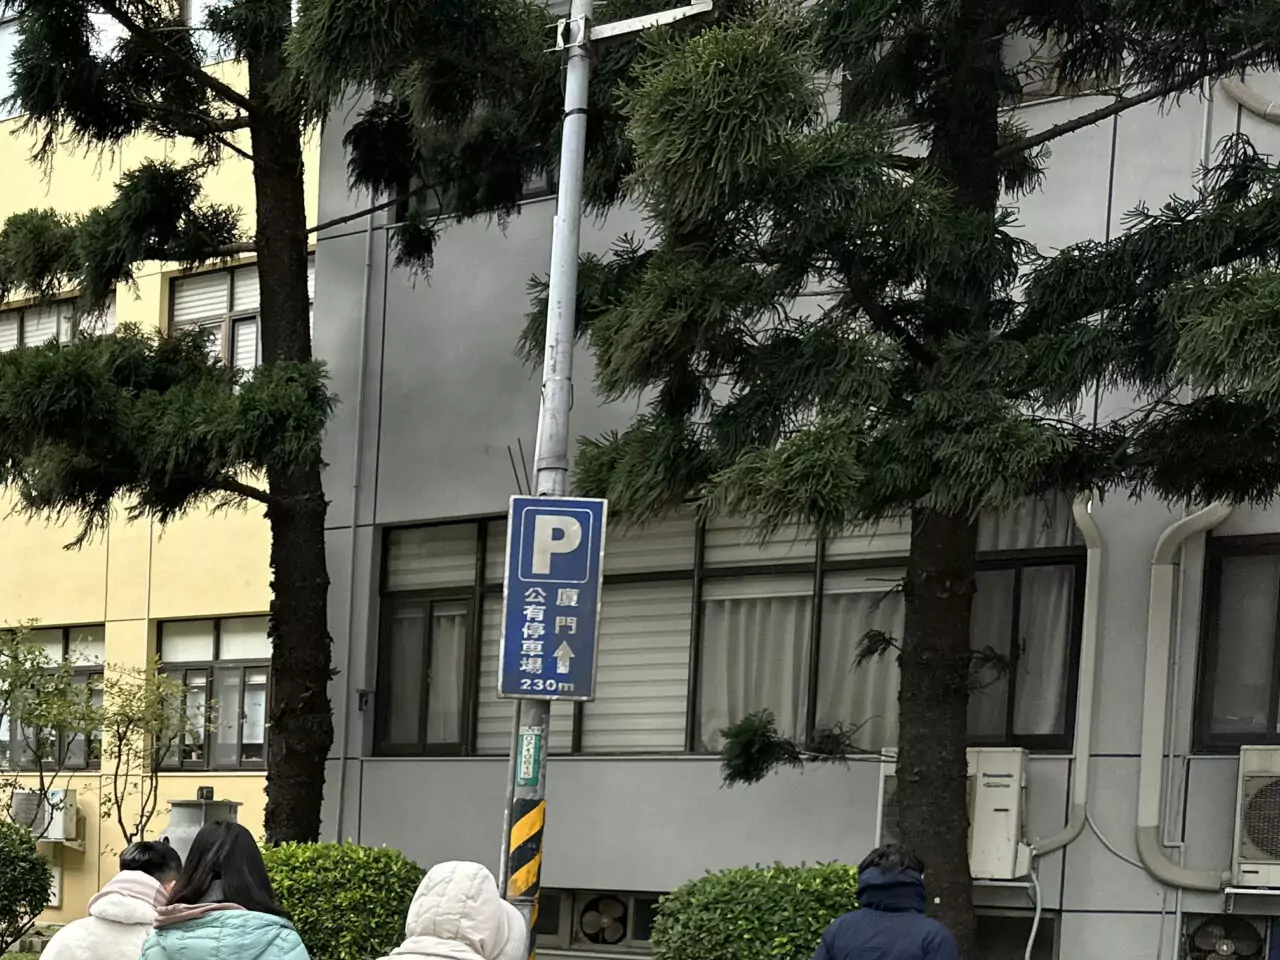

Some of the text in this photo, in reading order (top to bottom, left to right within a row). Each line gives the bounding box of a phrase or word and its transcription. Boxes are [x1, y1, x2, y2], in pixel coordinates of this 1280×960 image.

[532, 514, 582, 574] P
[519, 587, 547, 674] 公有停車場
[555, 588, 580, 634] 廈門
[520, 679, 574, 691] 230m
